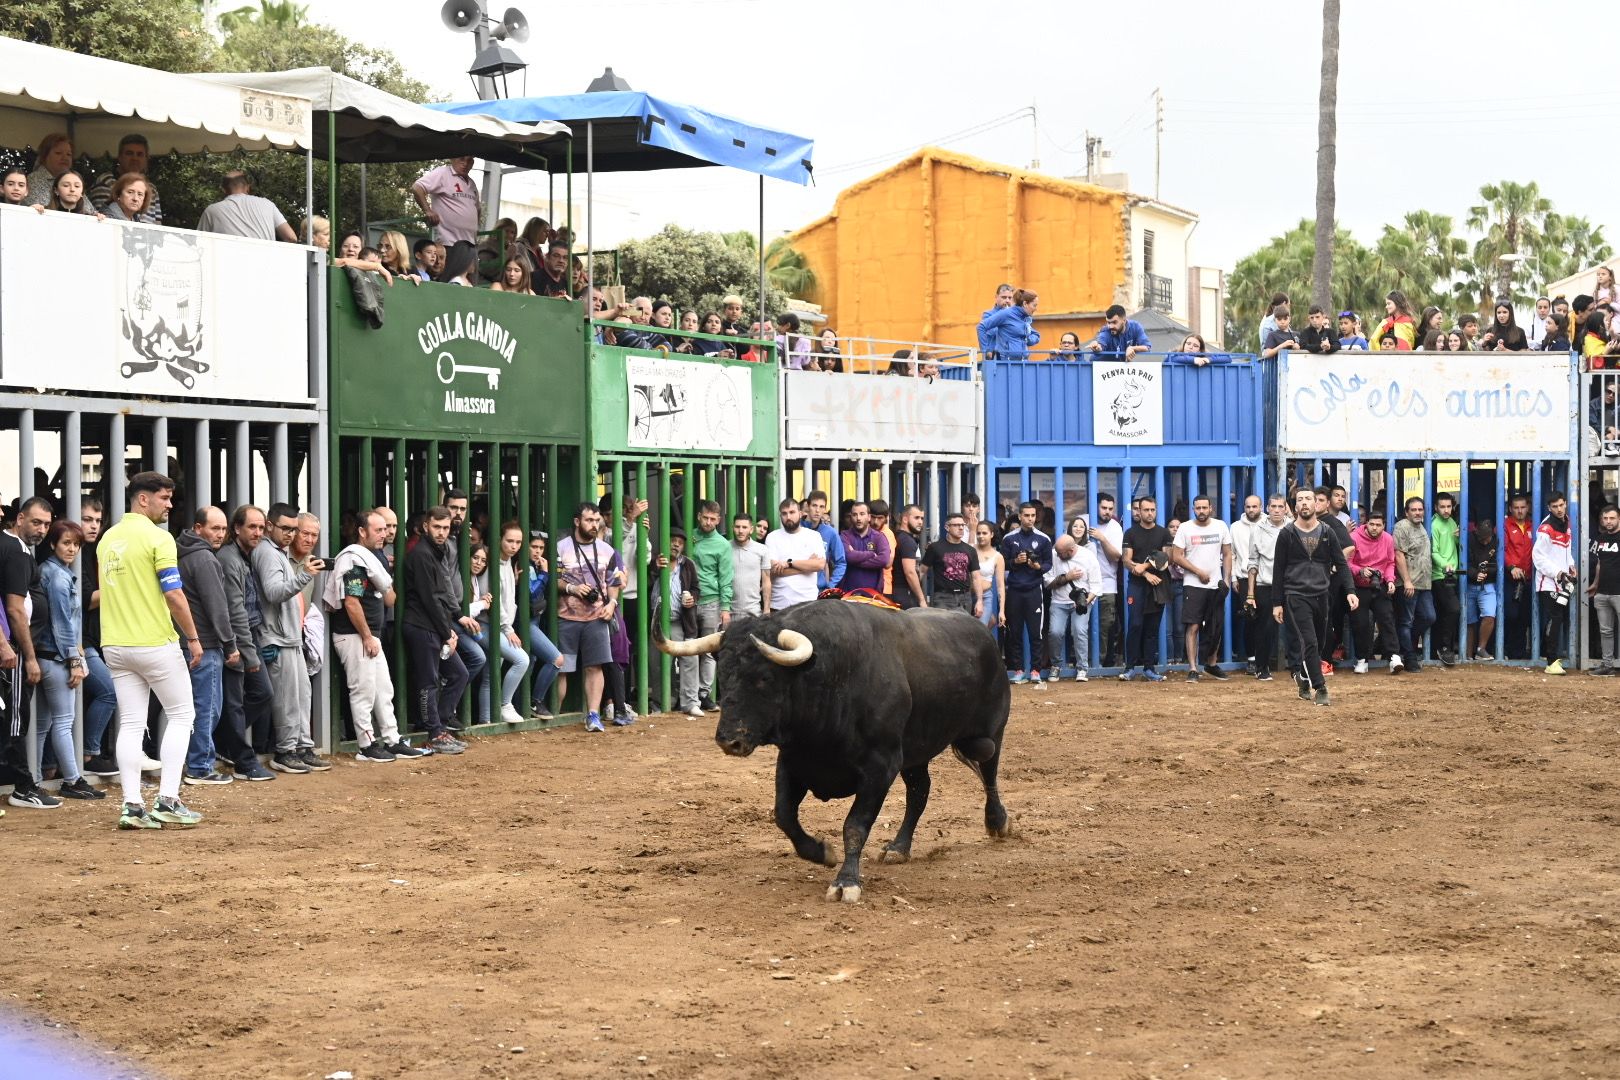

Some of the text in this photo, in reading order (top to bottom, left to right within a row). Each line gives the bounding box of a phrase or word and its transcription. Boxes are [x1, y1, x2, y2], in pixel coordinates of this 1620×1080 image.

[418, 312, 517, 363] COLLA GANDIA
[1101, 368, 1125, 381] PENYA
[1138, 370, 1154, 381] PAU
[444, 390, 496, 414] Almassora
[1367, 381, 1428, 417] els
[1445, 383, 1552, 417] amics
[1108, 429, 1149, 438] ALMASSORA
[1597, 541, 1619, 553] FILA
